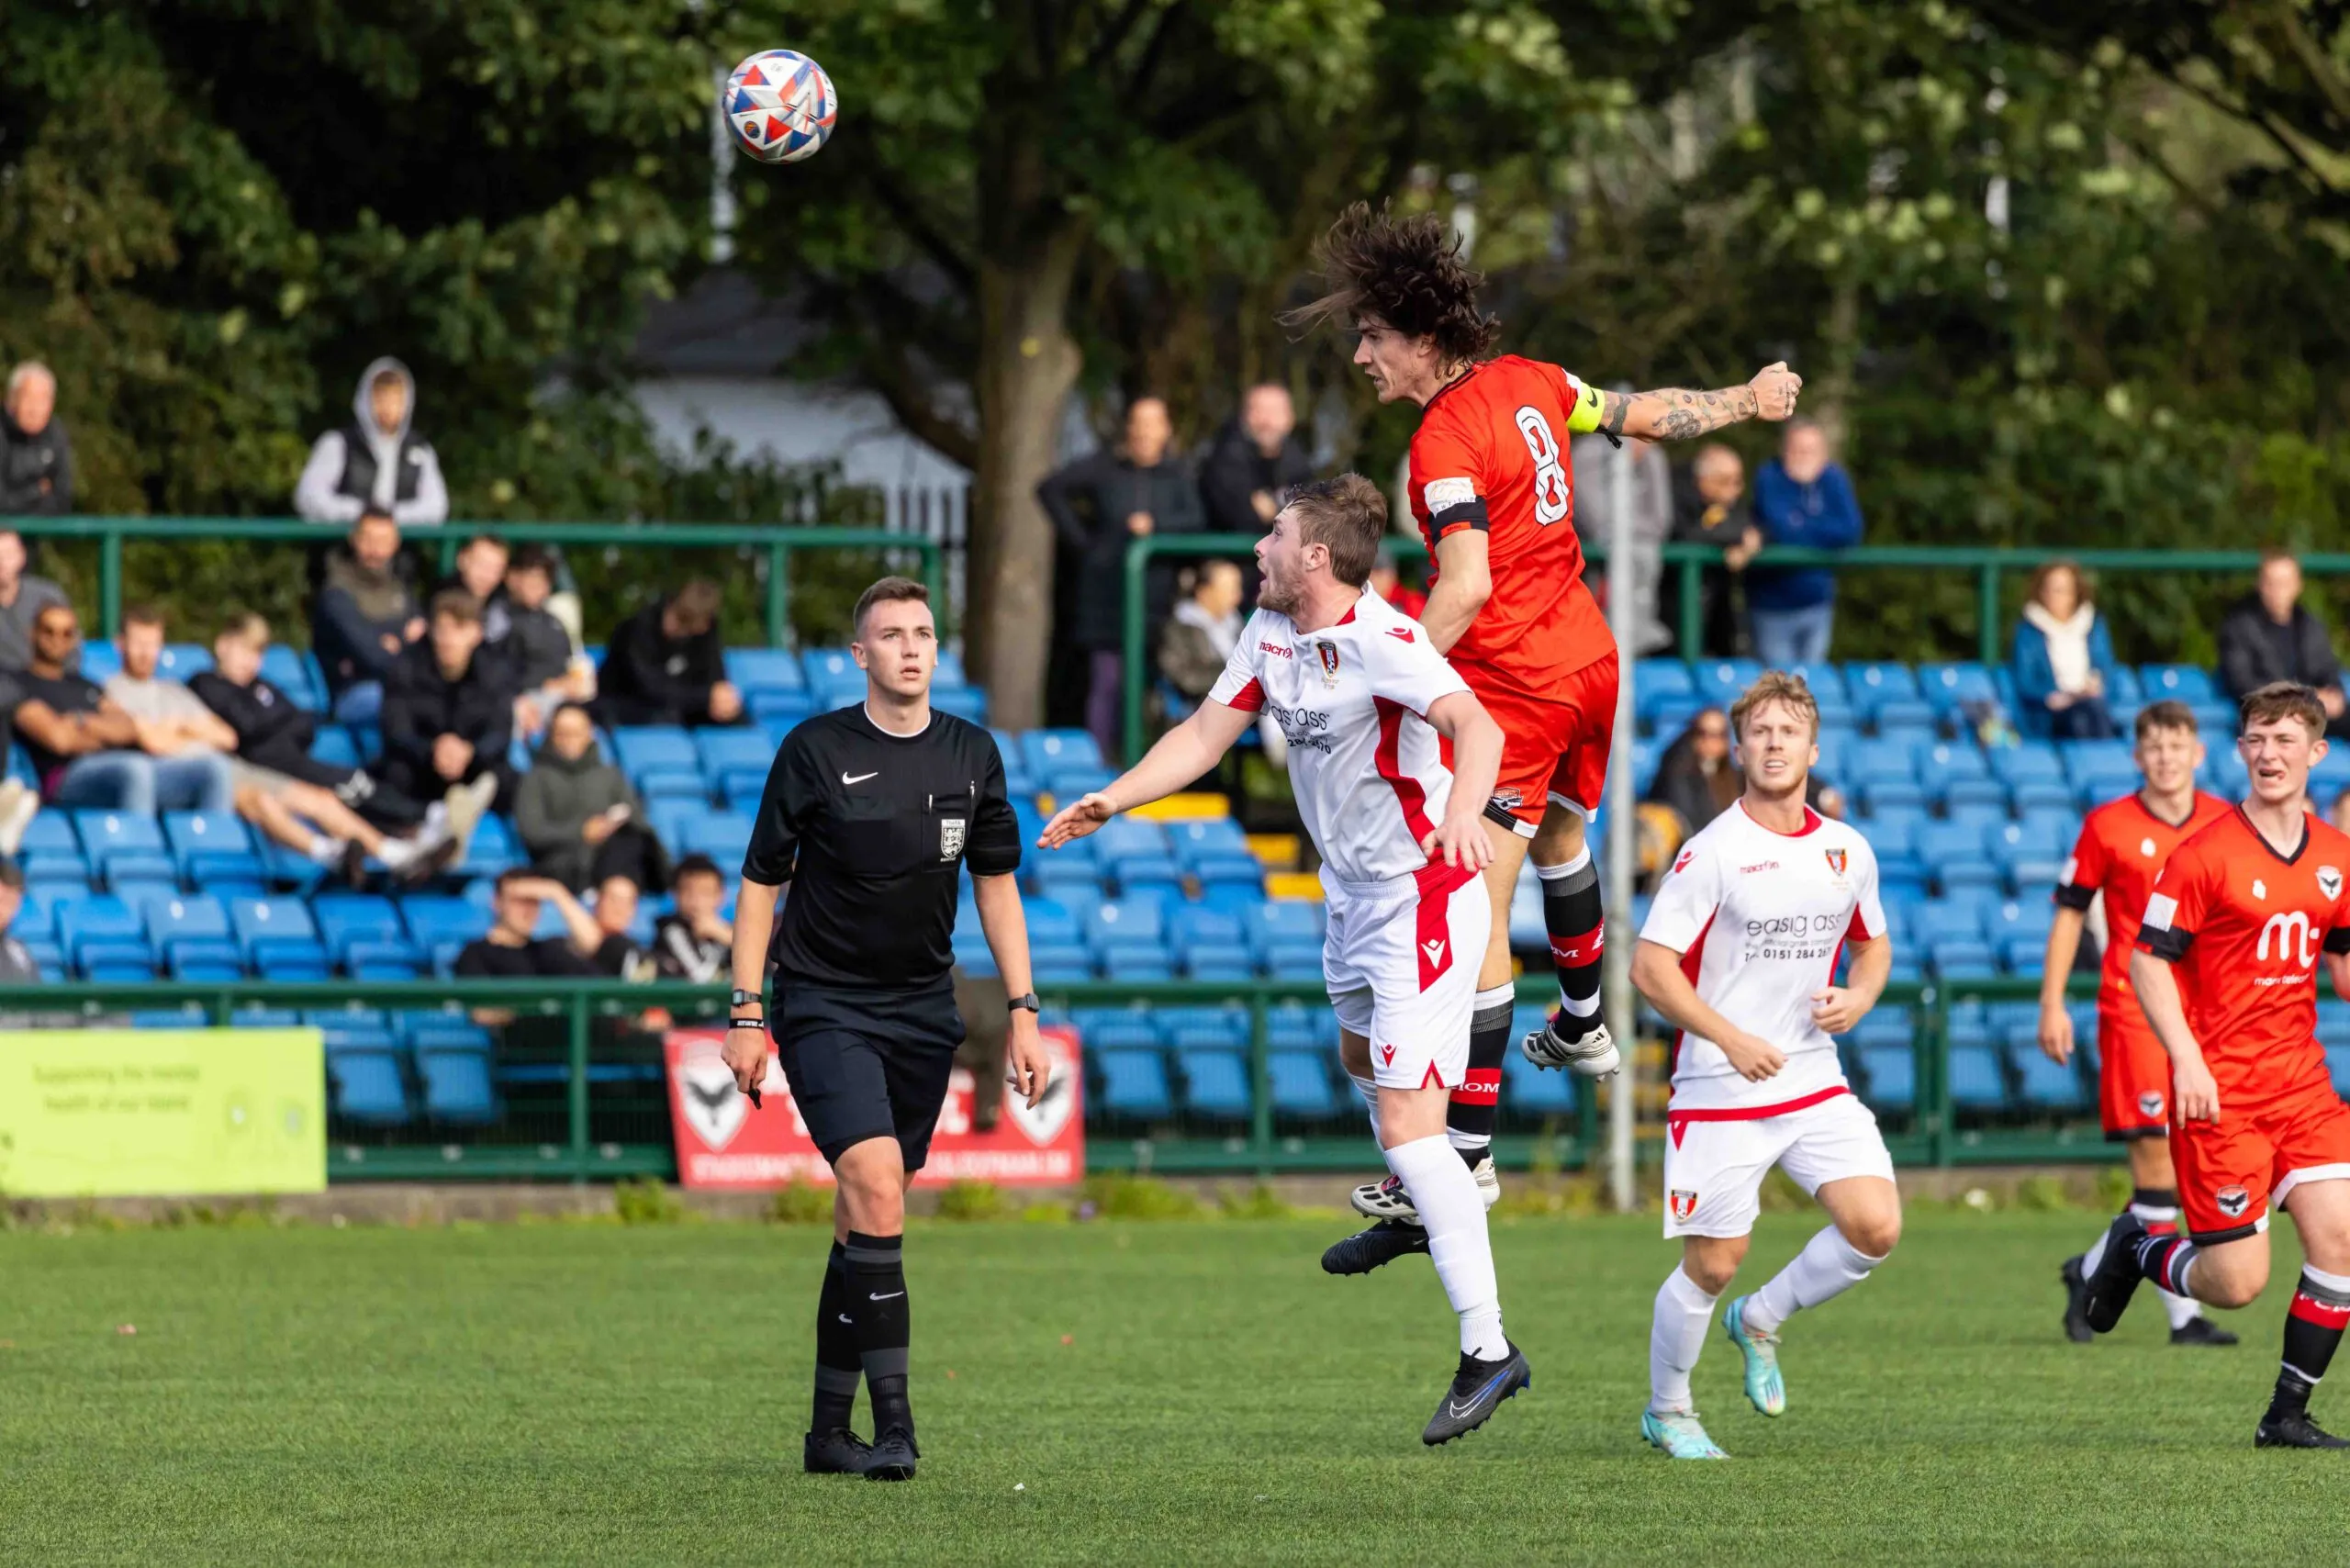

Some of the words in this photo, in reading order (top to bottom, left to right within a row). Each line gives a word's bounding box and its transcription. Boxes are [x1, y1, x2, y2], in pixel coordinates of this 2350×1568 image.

[1516, 405, 1569, 526] 8
[1763, 948, 1791, 959] 0151
[1796, 949, 1814, 959] 284
